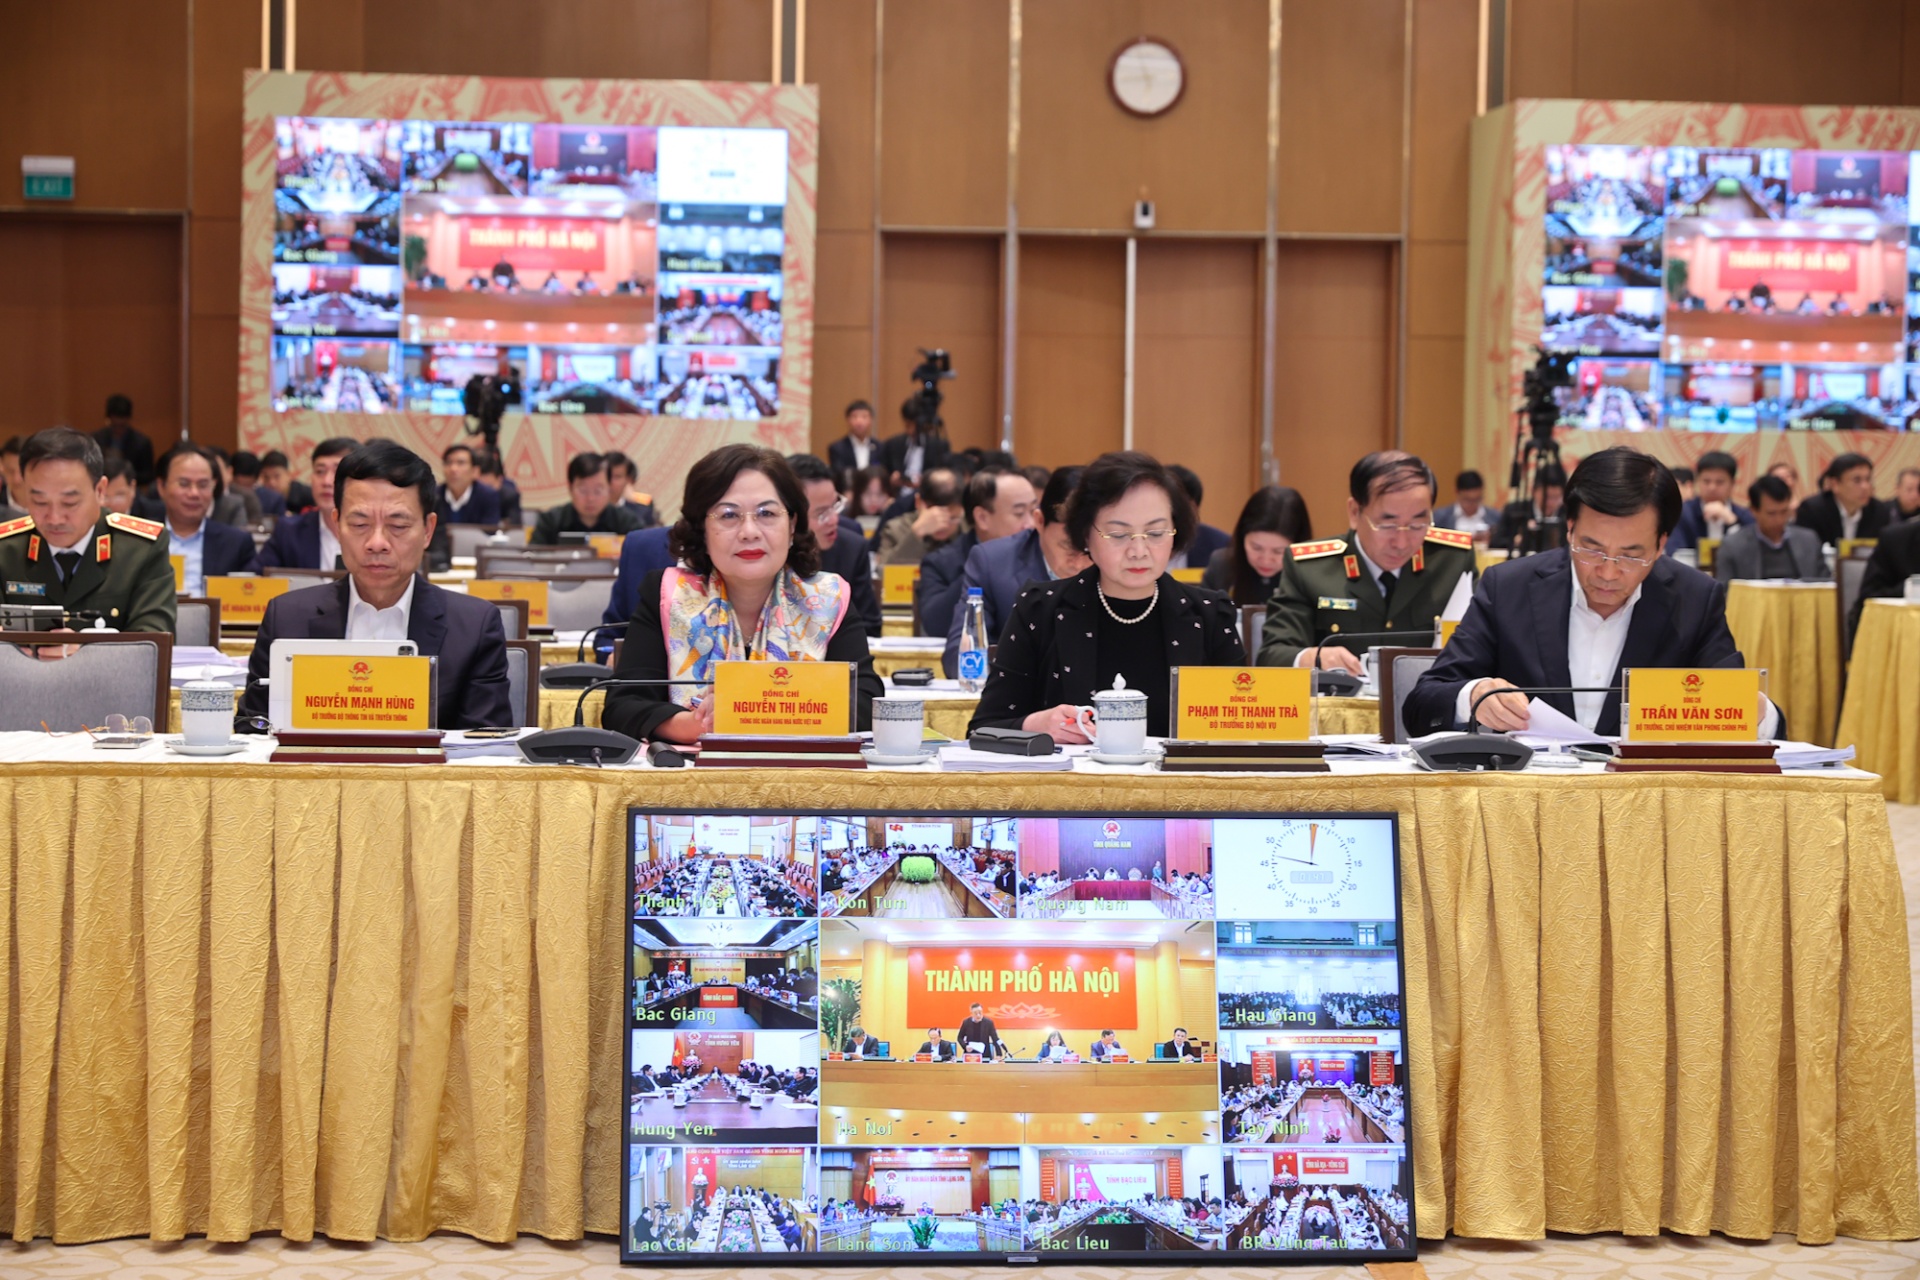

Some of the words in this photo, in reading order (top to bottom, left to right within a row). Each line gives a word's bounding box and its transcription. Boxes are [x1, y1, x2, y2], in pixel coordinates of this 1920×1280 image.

[785, 689, 800, 698] CHÍ
[305, 691, 348, 708] NGUYỄN
[351, 696, 383, 712] MẠNH
[385, 694, 415, 710] HÙNG
[733, 697, 776, 713] NGUYỄN
[778, 701, 796, 717] THỊ
[1187, 705, 1219, 720] PHẠM
[1221, 705, 1239, 720] THỊ
[1240, 706, 1276, 718] THANH
[1278, 703, 1299, 718] TRÀ
[1681, 705, 1710, 720] VĂN
[1713, 706, 1744, 720] SƠN
[1209, 720, 1218, 730] BỘ
[1245, 720, 1255, 731] BỘ
[1255, 720, 1267, 731] NỘI
[1267, 721, 1277, 731] VỤ
[1265, 836, 1275, 845] 50
[1346, 836, 1356, 845] 10
[1260, 860, 1270, 868] 45
[1353, 859, 1363, 868] 15
[1266, 882, 1277, 891] 40
[1347, 882, 1358, 891] 20
[637, 894, 686, 909] Thanh
[692, 895, 724, 909] Hoa
[837, 896, 868, 910] Kon
[874, 896, 908, 910] Tum
[1035, 897, 1087, 915] Quang
[1093, 897, 1129, 911] Nam
[1284, 899, 1294, 908] 35
[1331, 900, 1341, 908] 25
[1308, 906, 1318, 914] 30
[924, 965, 994, 992] THÀNH
[1000, 962, 1045, 993] PHỐ
[1049, 965, 1078, 993] HÀ
[1083, 966, 1120, 998] NỘI
[635, 1006, 665, 1021] Bac
[669, 1006, 716, 1025] Giang
[1235, 1008, 1265, 1022] Hau
[1271, 1007, 1317, 1026] Giang
[634, 1122, 676, 1140] Hung
[682, 1121, 715, 1136] Yen
[837, 1121, 858, 1136] Ha
[865, 1120, 893, 1136] Noi
[1238, 1121, 1266, 1139] Tay
[1272, 1120, 1309, 1135] Ninh
[632, 1237, 661, 1252] Lao
[667, 1237, 692, 1252] Cai
[882, 1237, 913, 1251] Son
[1041, 1236, 1070, 1250] Bac
[1076, 1235, 1110, 1250] Lieu
[1319, 1235, 1349, 1249] Tau
